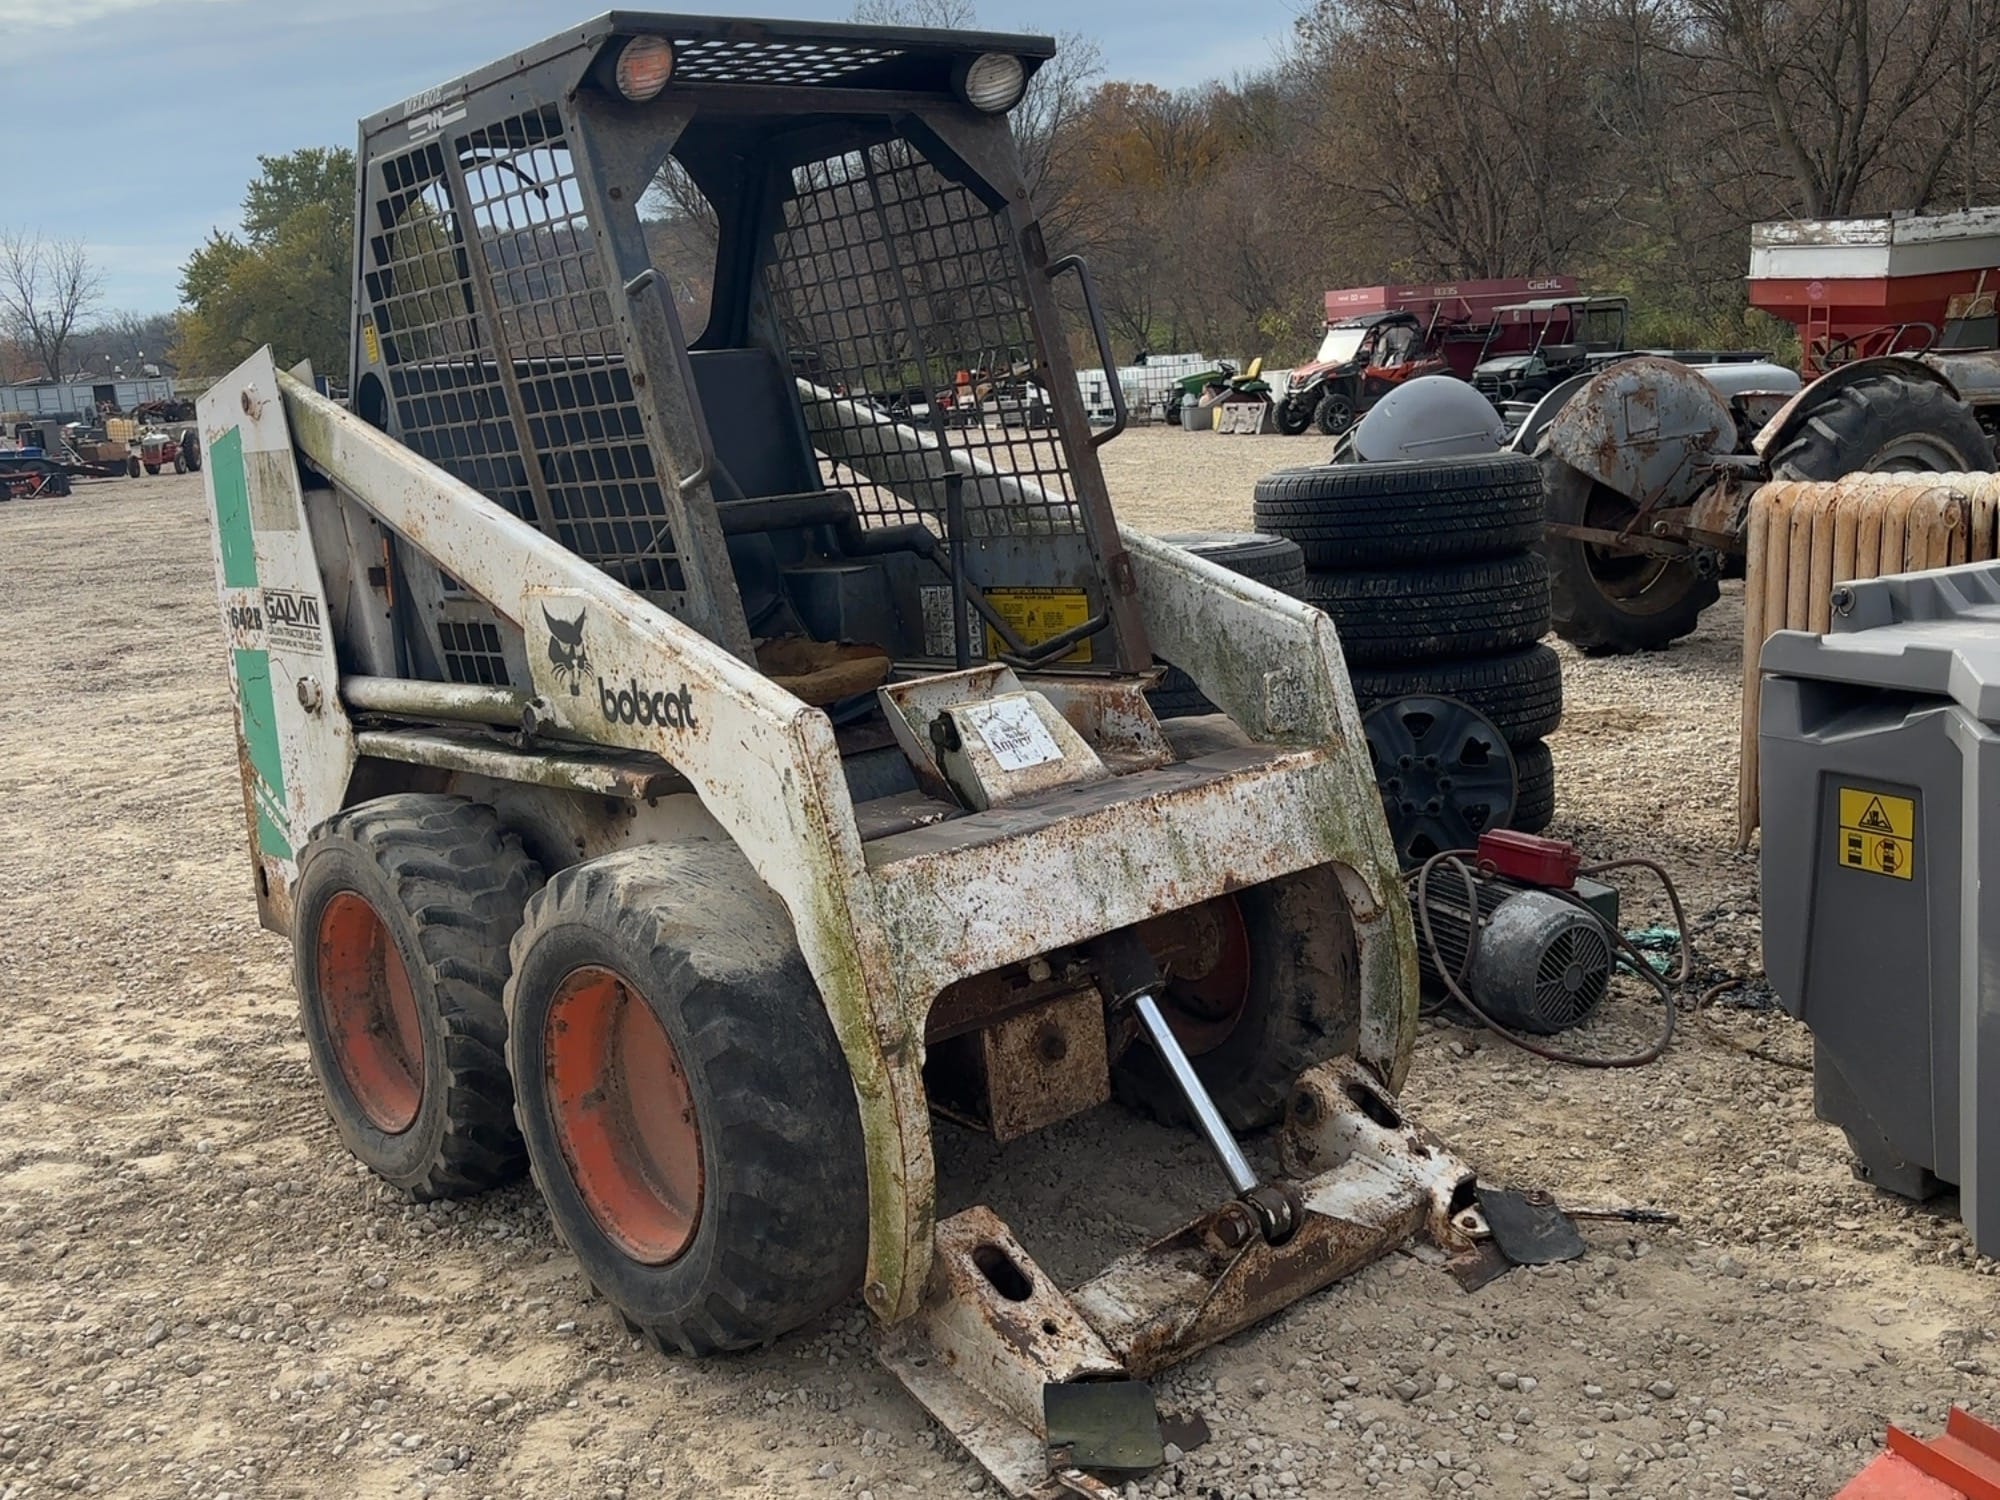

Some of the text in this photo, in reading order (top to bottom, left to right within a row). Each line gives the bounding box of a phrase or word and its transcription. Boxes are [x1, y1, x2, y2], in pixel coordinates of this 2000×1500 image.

[403, 87, 442, 117] MELROE
[231, 606, 263, 630] 642B
[263, 592, 320, 630] GALVIN
[598, 677, 695, 729] bobcat
